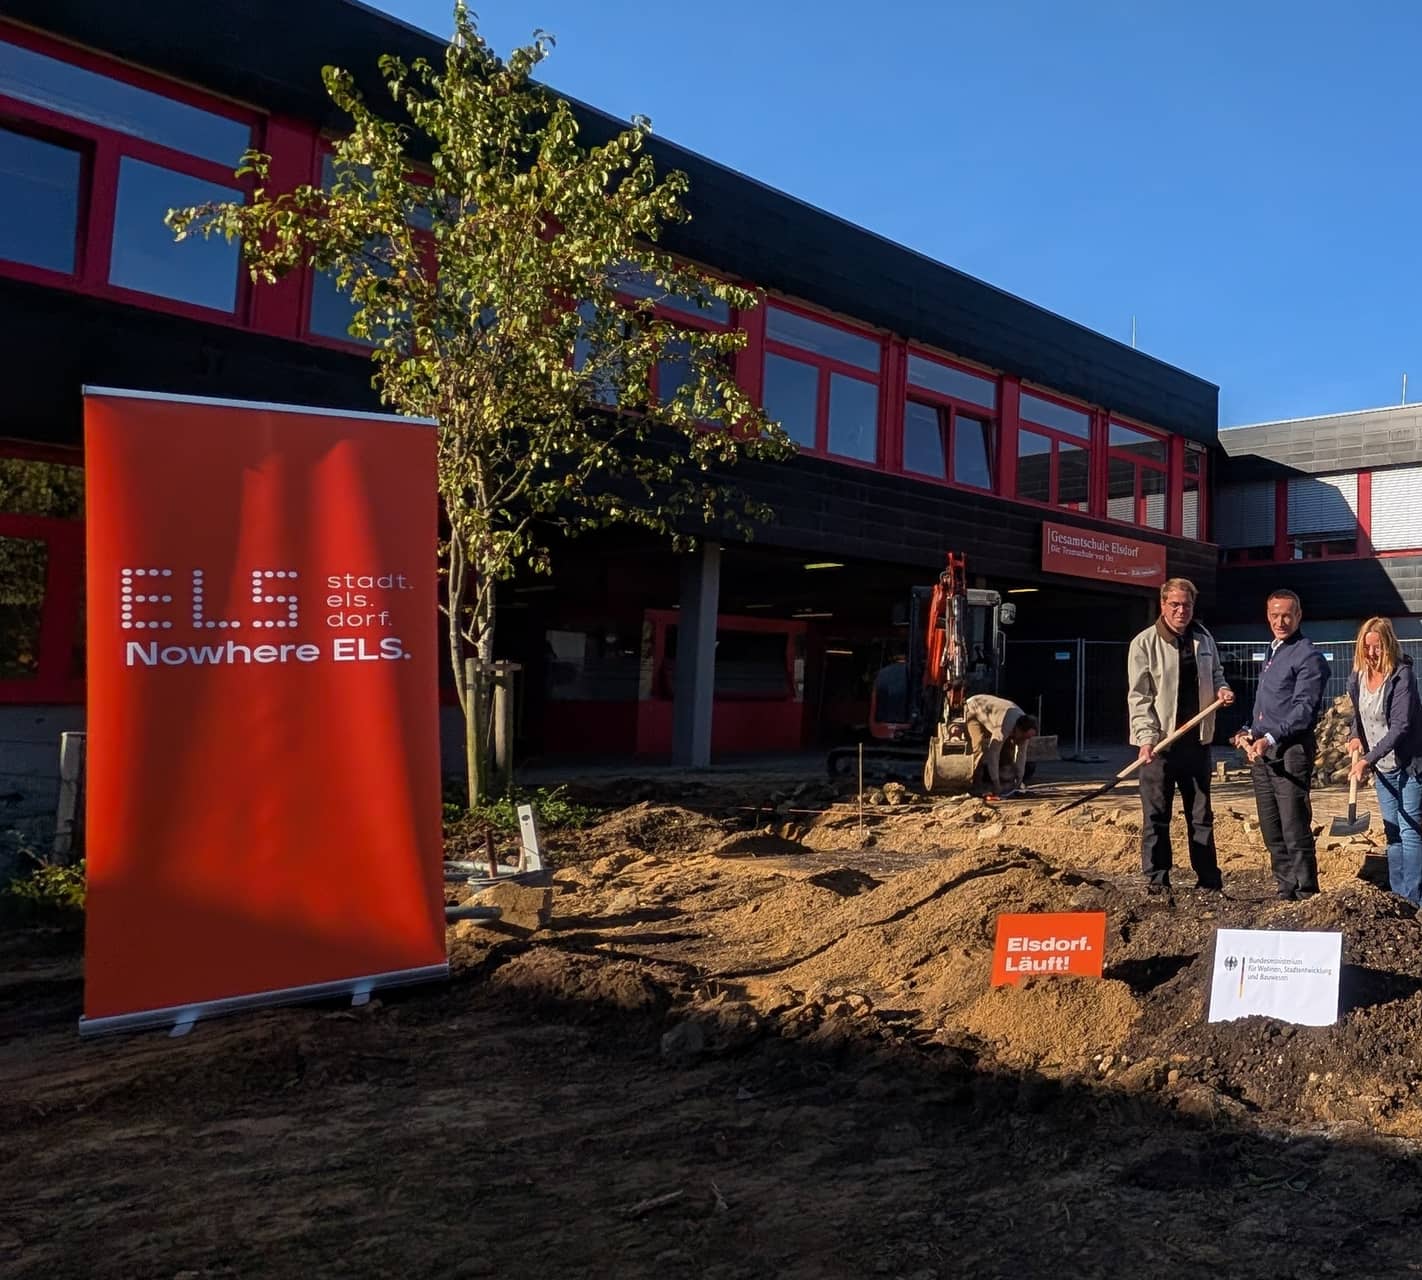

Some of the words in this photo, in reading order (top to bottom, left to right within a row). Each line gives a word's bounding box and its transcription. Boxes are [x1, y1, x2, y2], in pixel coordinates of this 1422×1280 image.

[1051, 530, 1110, 552] Gesamtschule
[1111, 542, 1139, 558] Elsdorf
[326, 572, 415, 590] stadt.
[121, 568, 298, 629] ELS
[326, 592, 375, 607] els.
[326, 611, 393, 627] dorf.
[126, 640, 320, 666] Nowhere
[333, 637, 412, 662] ELS.
[1007, 936, 1093, 952] Elsdorf.
[1005, 955, 1070, 972] Läuft!
